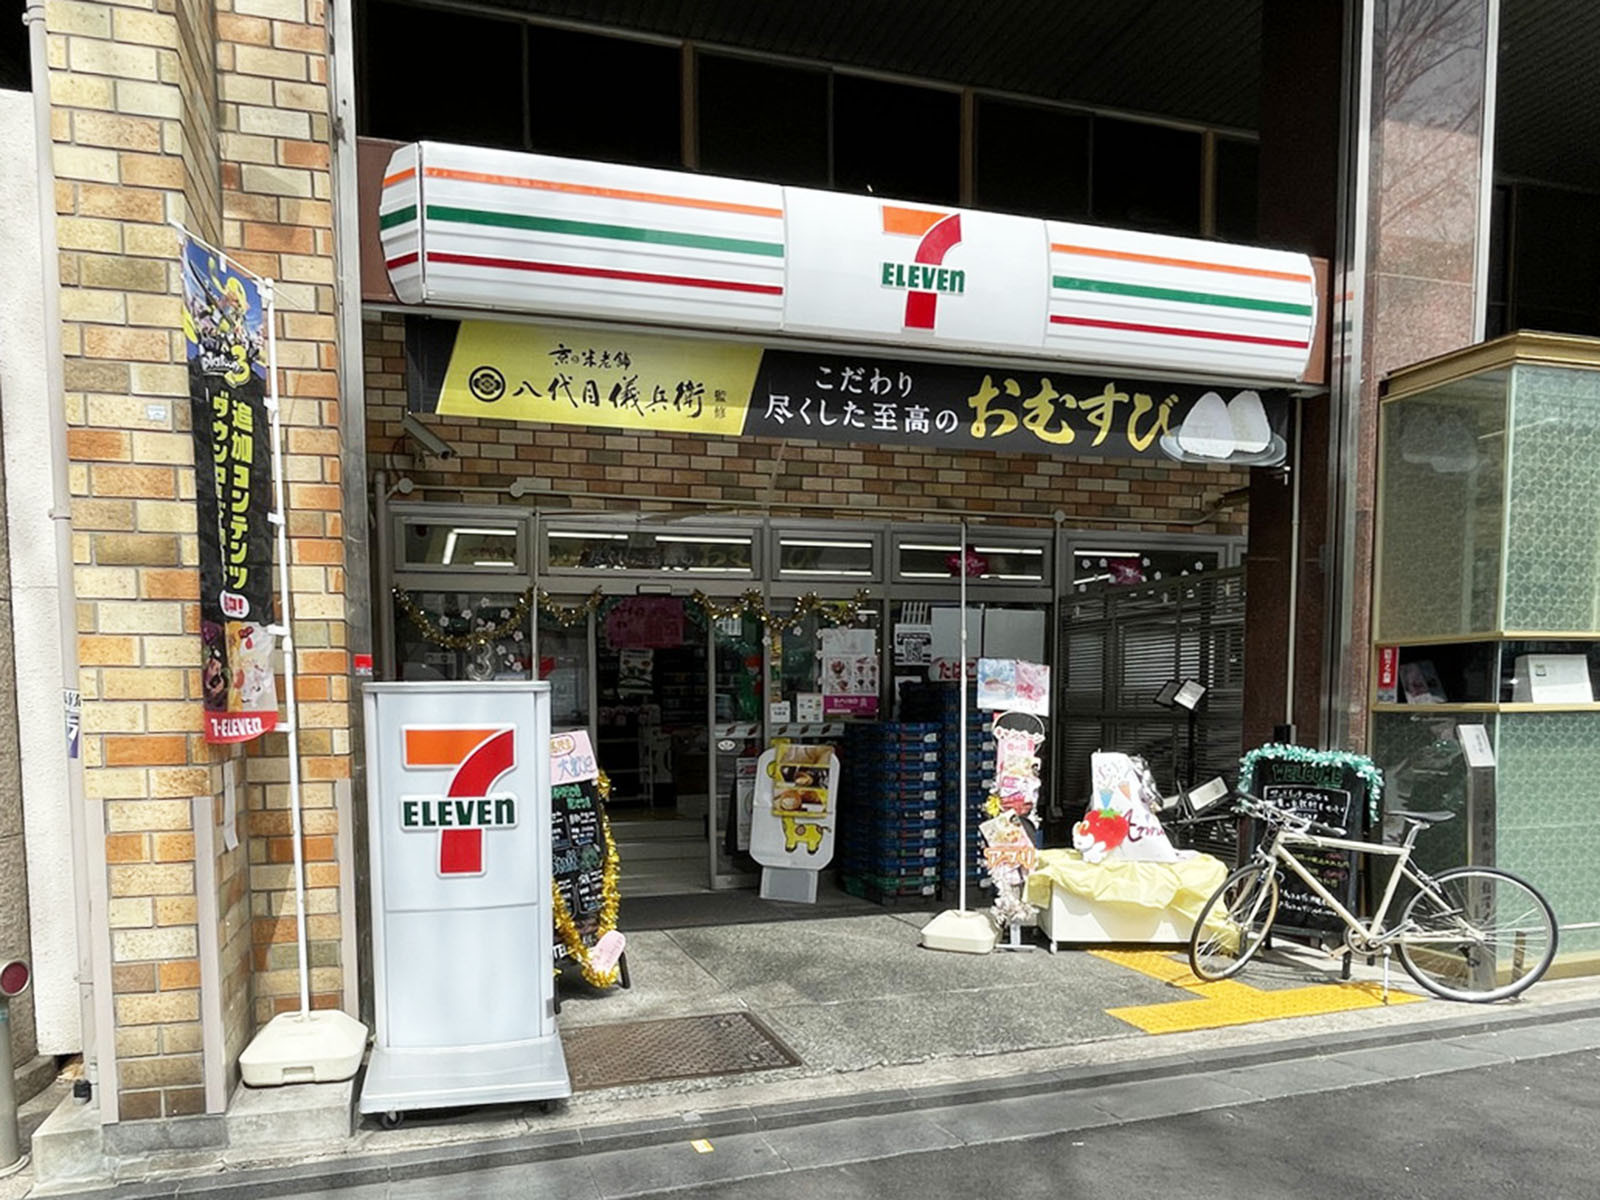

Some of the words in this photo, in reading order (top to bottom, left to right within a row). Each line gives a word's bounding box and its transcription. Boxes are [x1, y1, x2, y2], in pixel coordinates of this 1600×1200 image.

[882, 205, 962, 330] 7
[512, 373, 706, 419] 八代目儀兵衛
[714, 388, 727, 420] 監修
[815, 365, 914, 399] こだわり
[763, 392, 959, 436] 尽くした至高の
[967, 373, 1180, 453] おむすび
[231, 399, 253, 589] 追加コンテンツ
[1272, 763, 1345, 784] WELCOME
[405, 729, 515, 874] 7
